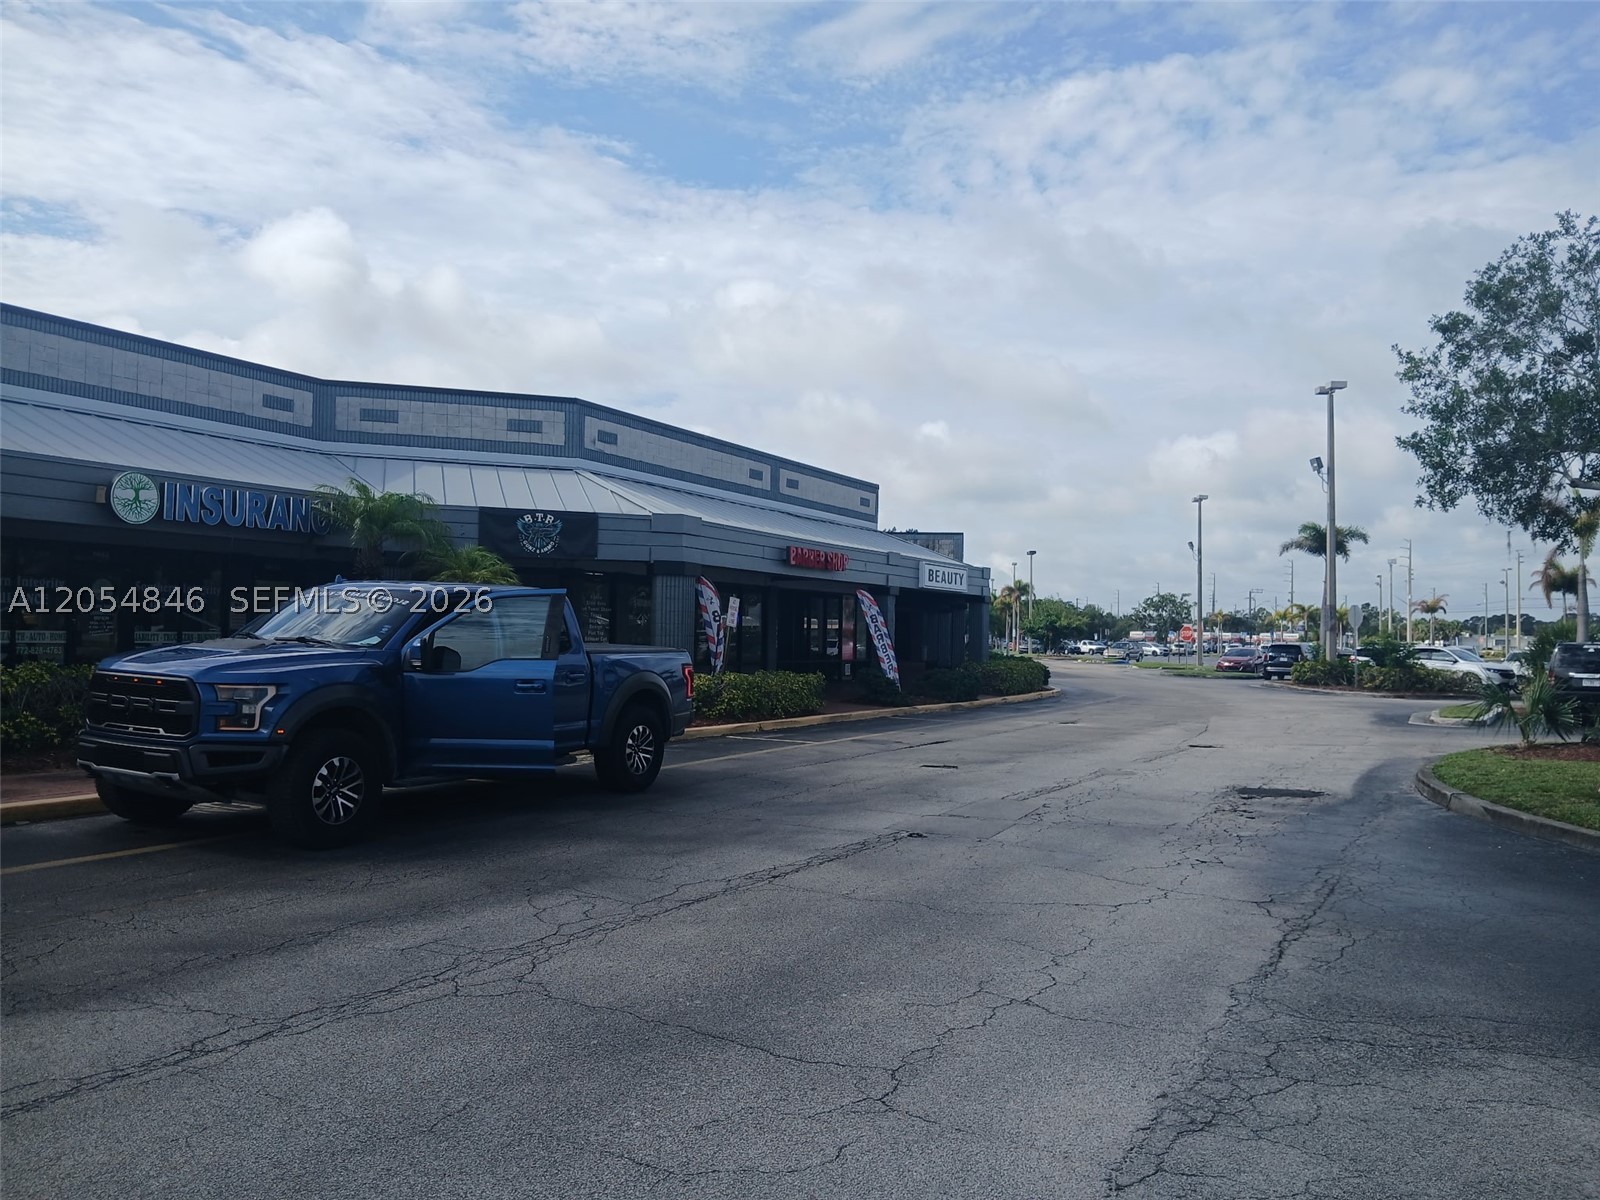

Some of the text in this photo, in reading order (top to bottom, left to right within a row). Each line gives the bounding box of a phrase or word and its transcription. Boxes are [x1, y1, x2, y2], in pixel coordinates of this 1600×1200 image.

[163, 481, 332, 536] INSURANC
[790, 546, 849, 572] BARBER SHOP
[928, 569, 964, 586] BEAUTY
[869, 614, 894, 673] BARBER
